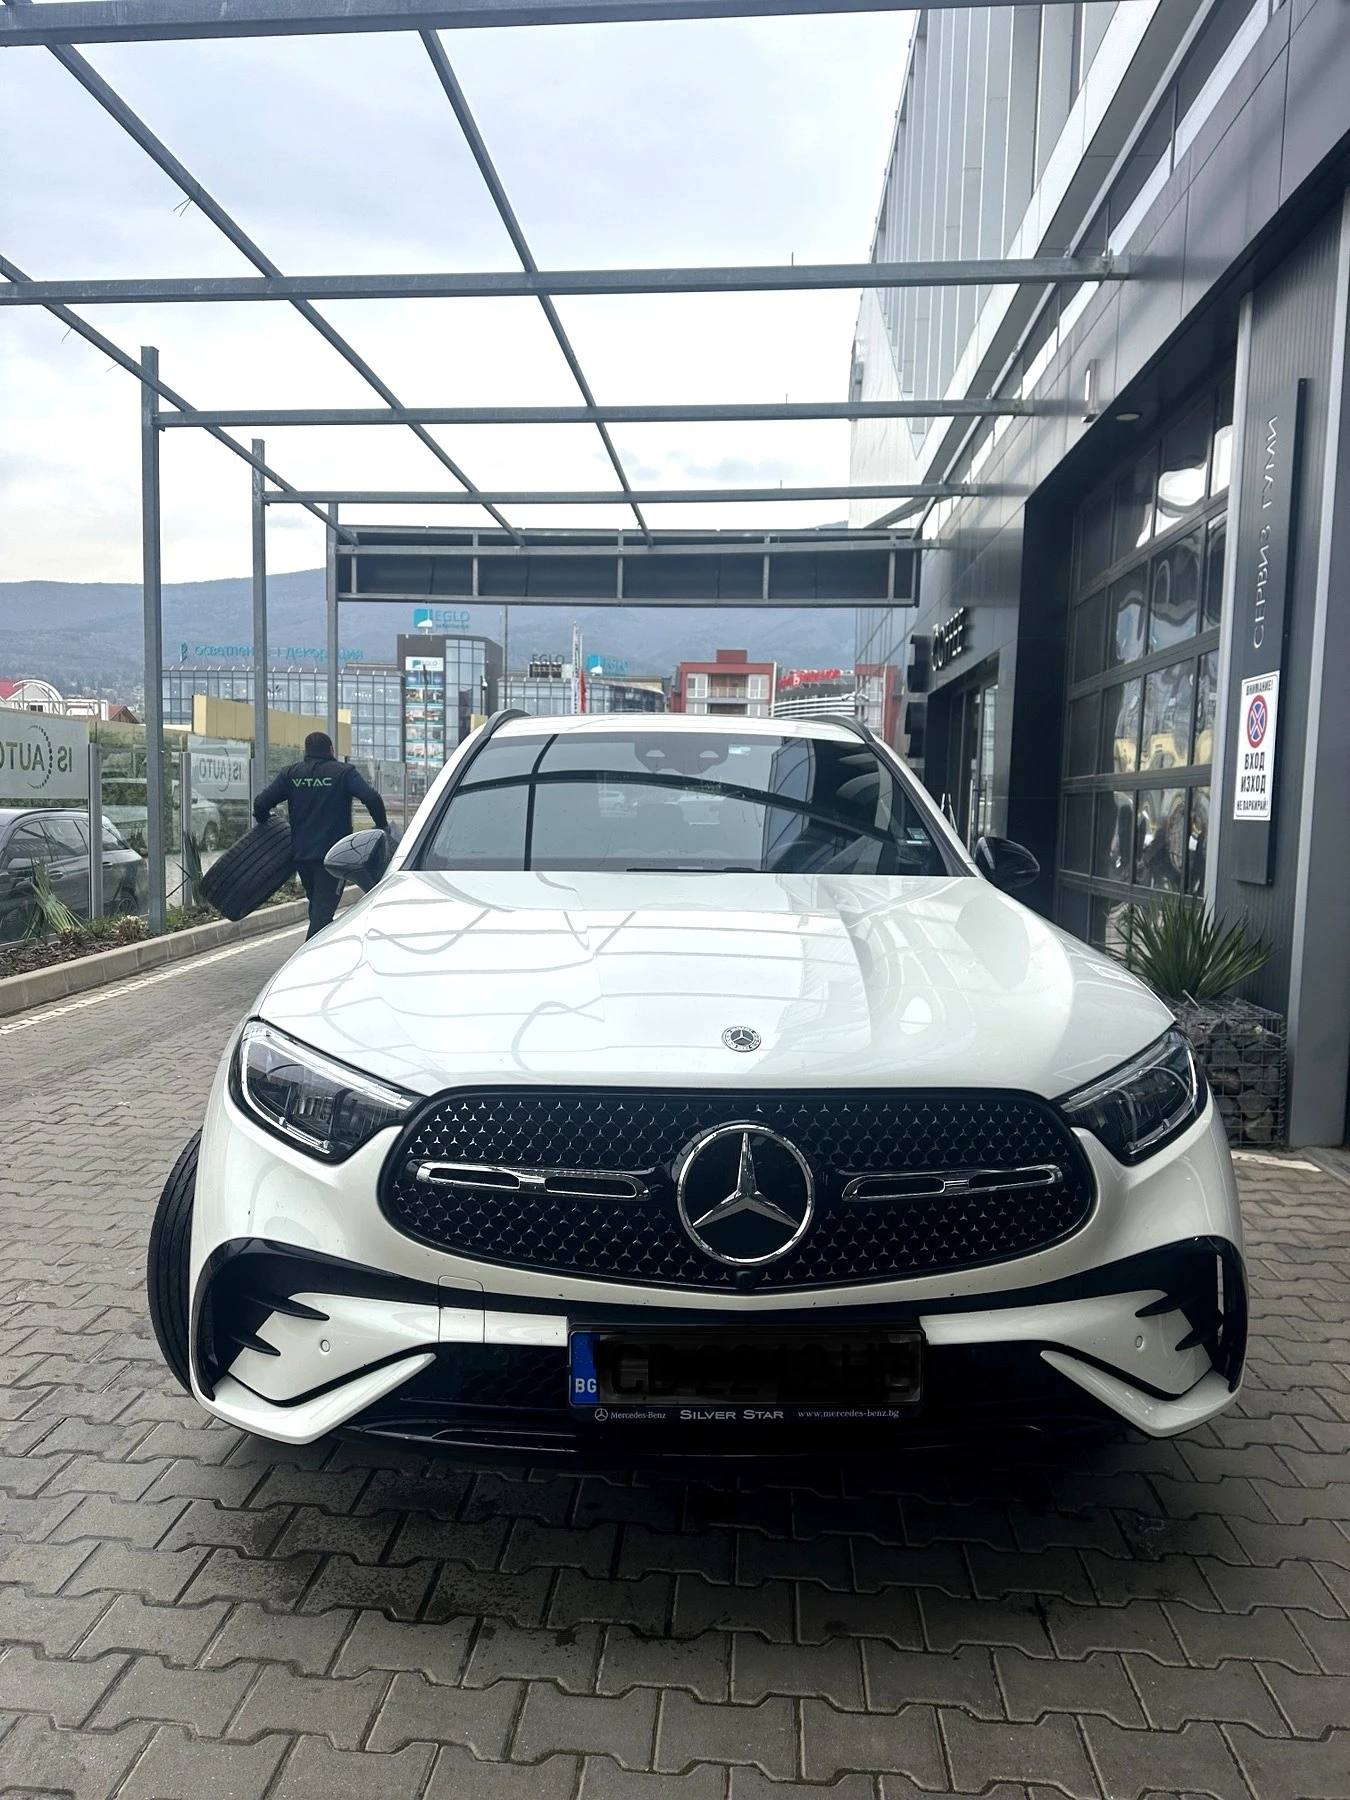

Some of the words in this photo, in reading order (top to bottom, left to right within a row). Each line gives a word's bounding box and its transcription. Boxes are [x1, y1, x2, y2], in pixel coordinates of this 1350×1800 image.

[1262, 416, 1278, 509] ГУМИ
[1253, 525, 1272, 649] СЕРВИЗ
[435, 610, 470, 622] EGLO
[195, 644, 270, 657] осветлен
[285, 645, 364, 660] декорция
[1246, 679, 1273, 696] ВНИМАНИЕ!
[1244, 751, 1265, 771] ВХОД
[292, 777, 332, 787] V-TAC
[1241, 775, 1266, 794] ИЗХОД
[1237, 799, 1243, 811] НЕ
[1243, 797, 1268, 811] ПАРКИРАЙ!
[574, 1378, 597, 1393] BG
[610, 1411, 666, 1419] Mercedes-Benz
[798, 1409, 899, 1418] www.mercedes-benz.bg
